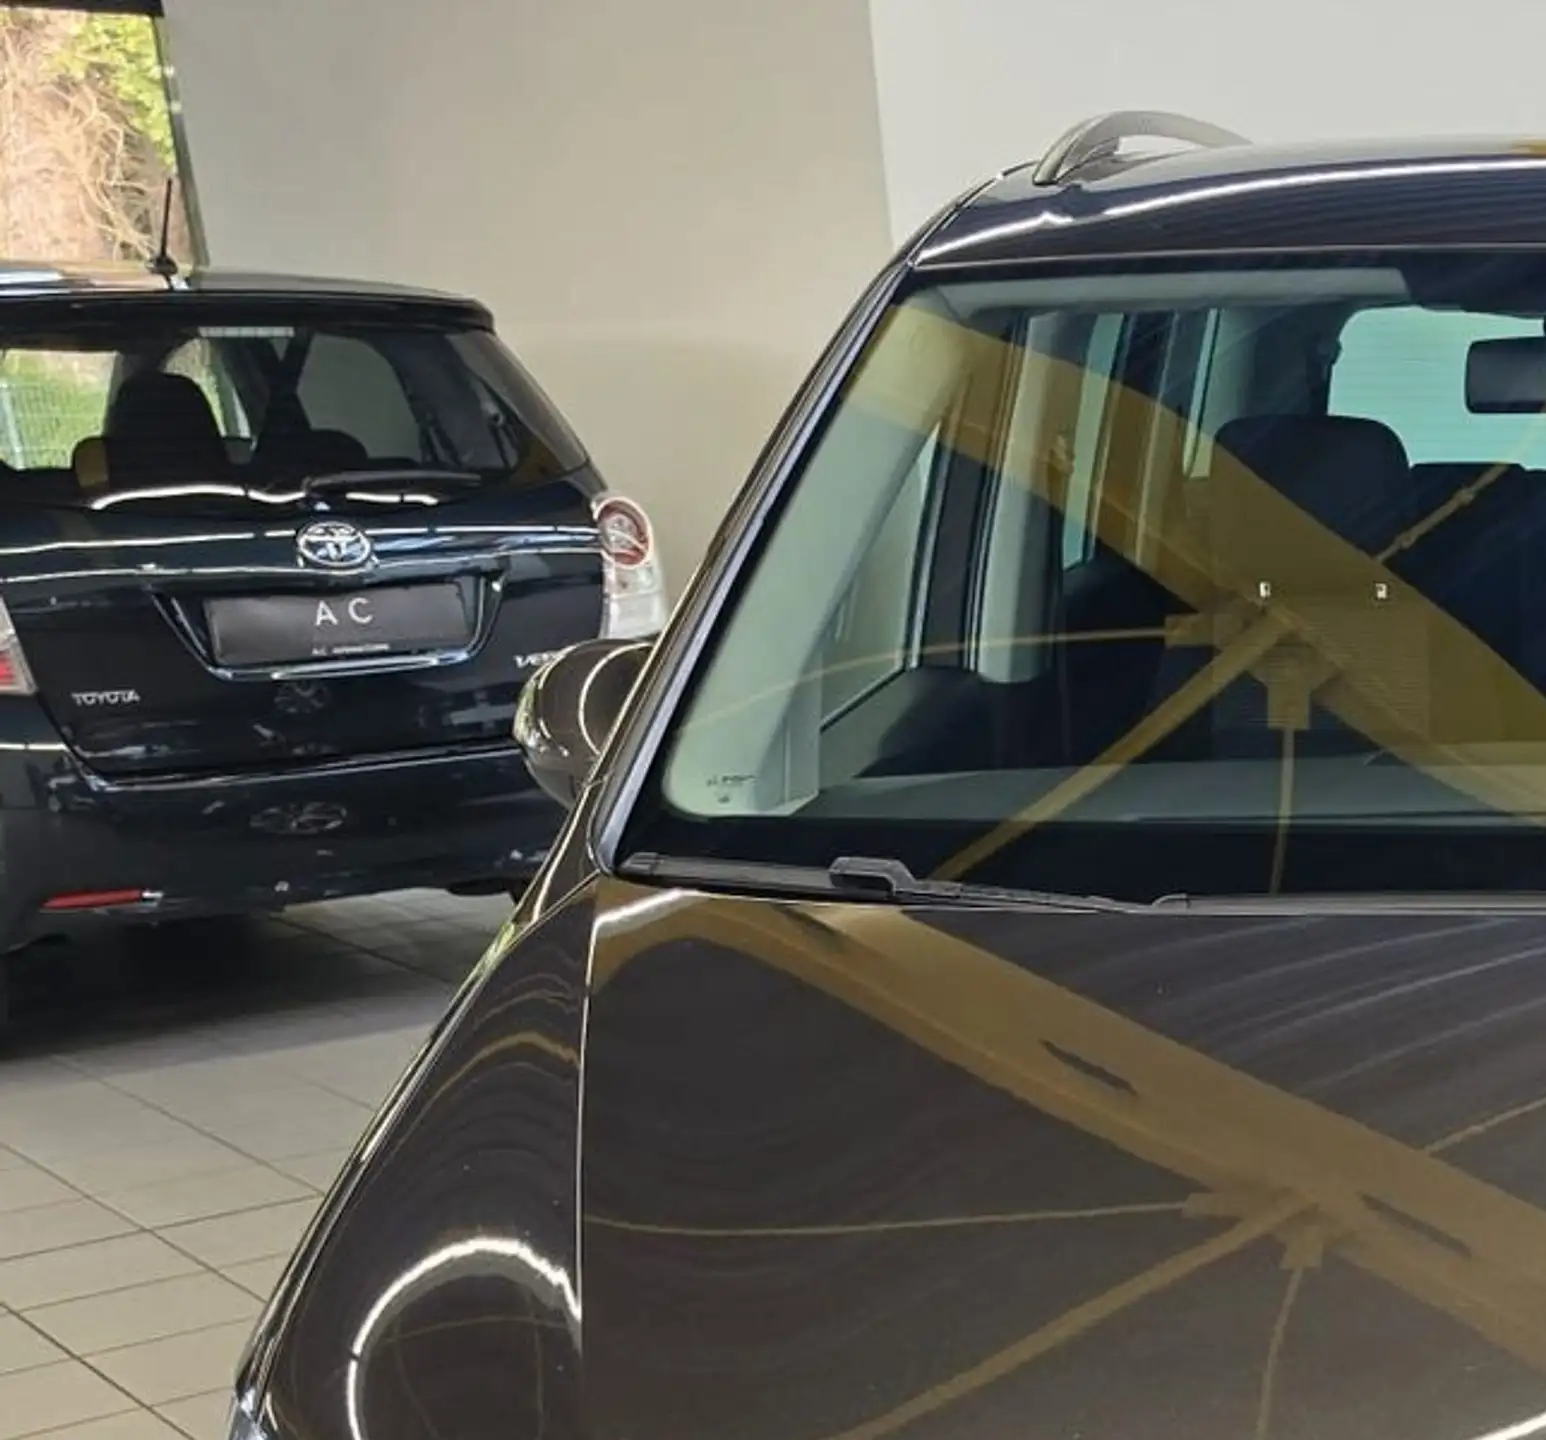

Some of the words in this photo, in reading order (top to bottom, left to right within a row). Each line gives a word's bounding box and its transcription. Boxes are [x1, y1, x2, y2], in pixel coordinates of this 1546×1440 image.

[314, 599, 339, 627] A
[347, 596, 374, 625] C
[70, 687, 141, 707] TOYOTA
